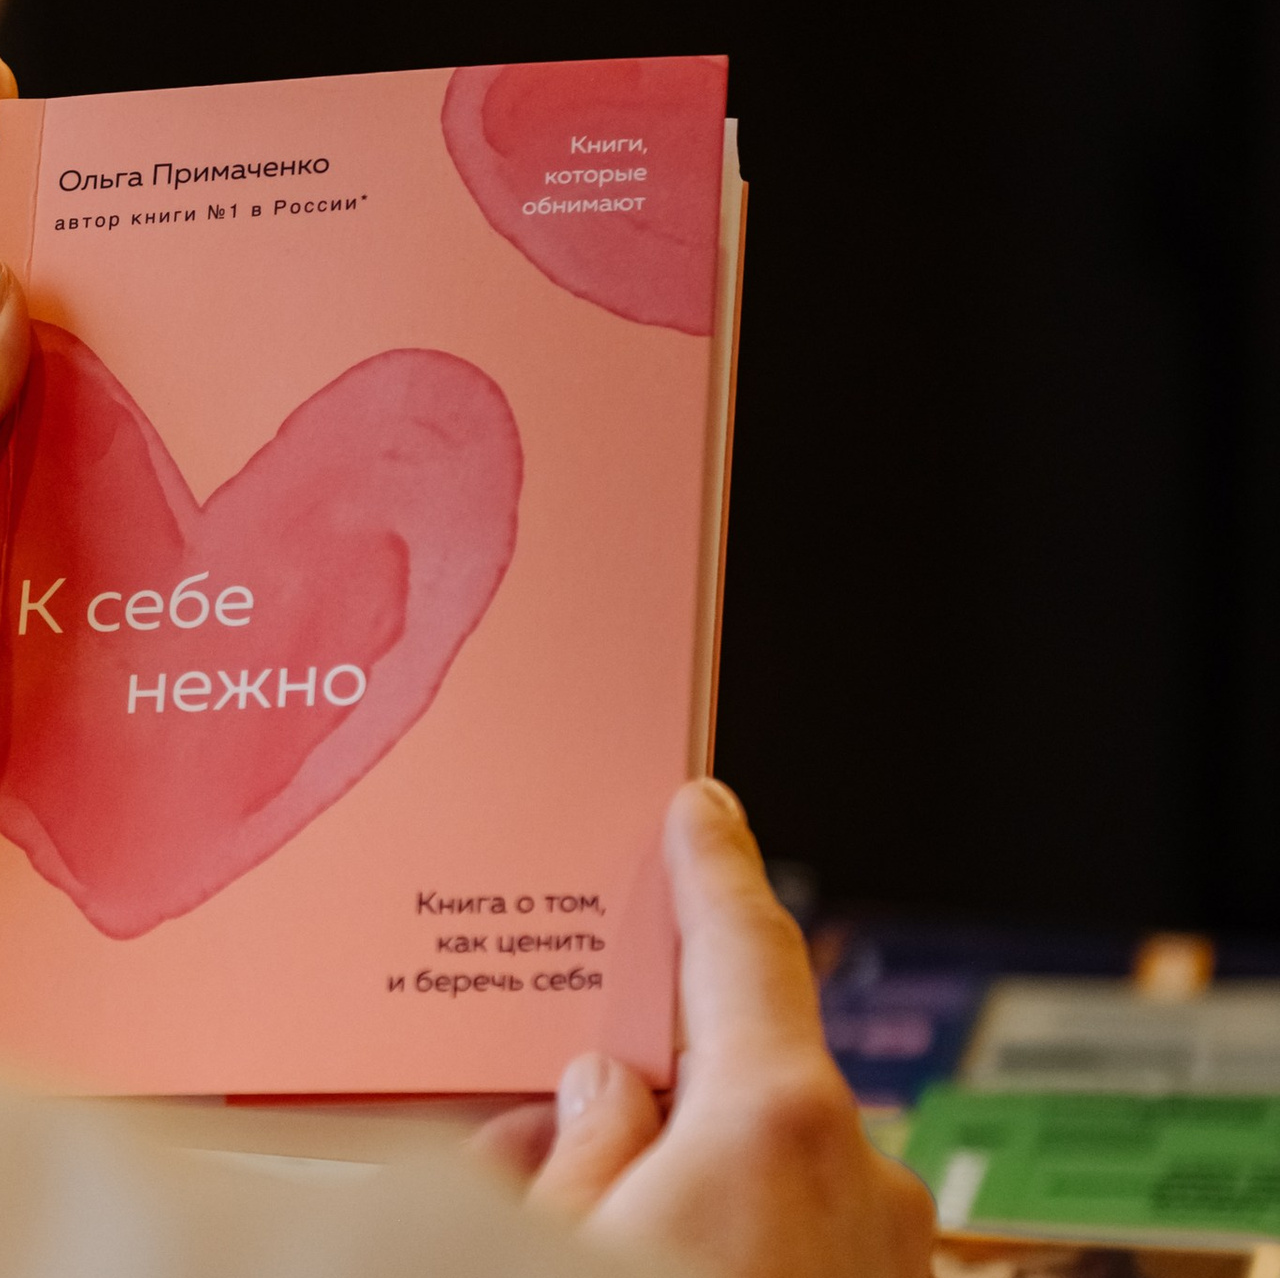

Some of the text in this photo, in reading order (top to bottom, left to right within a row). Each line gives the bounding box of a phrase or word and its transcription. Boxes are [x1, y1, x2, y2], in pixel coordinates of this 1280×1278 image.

[570, 135, 649, 155] Книги,
[58, 157, 331, 192] Ольга Примаченко
[544, 166, 648, 188] которые
[54, 214, 121, 231] автор
[130, 209, 197, 226] книги
[207, 203, 239, 221] №1
[251, 205, 263, 217] в
[521, 196, 647, 216] обнимают
[17, 570, 255, 636] К себе
[127, 663, 368, 715] нежно
[416, 891, 608, 917] Книга о том,
[436, 933, 607, 956] как ценить
[387, 967, 604, 999] и беречь себя
